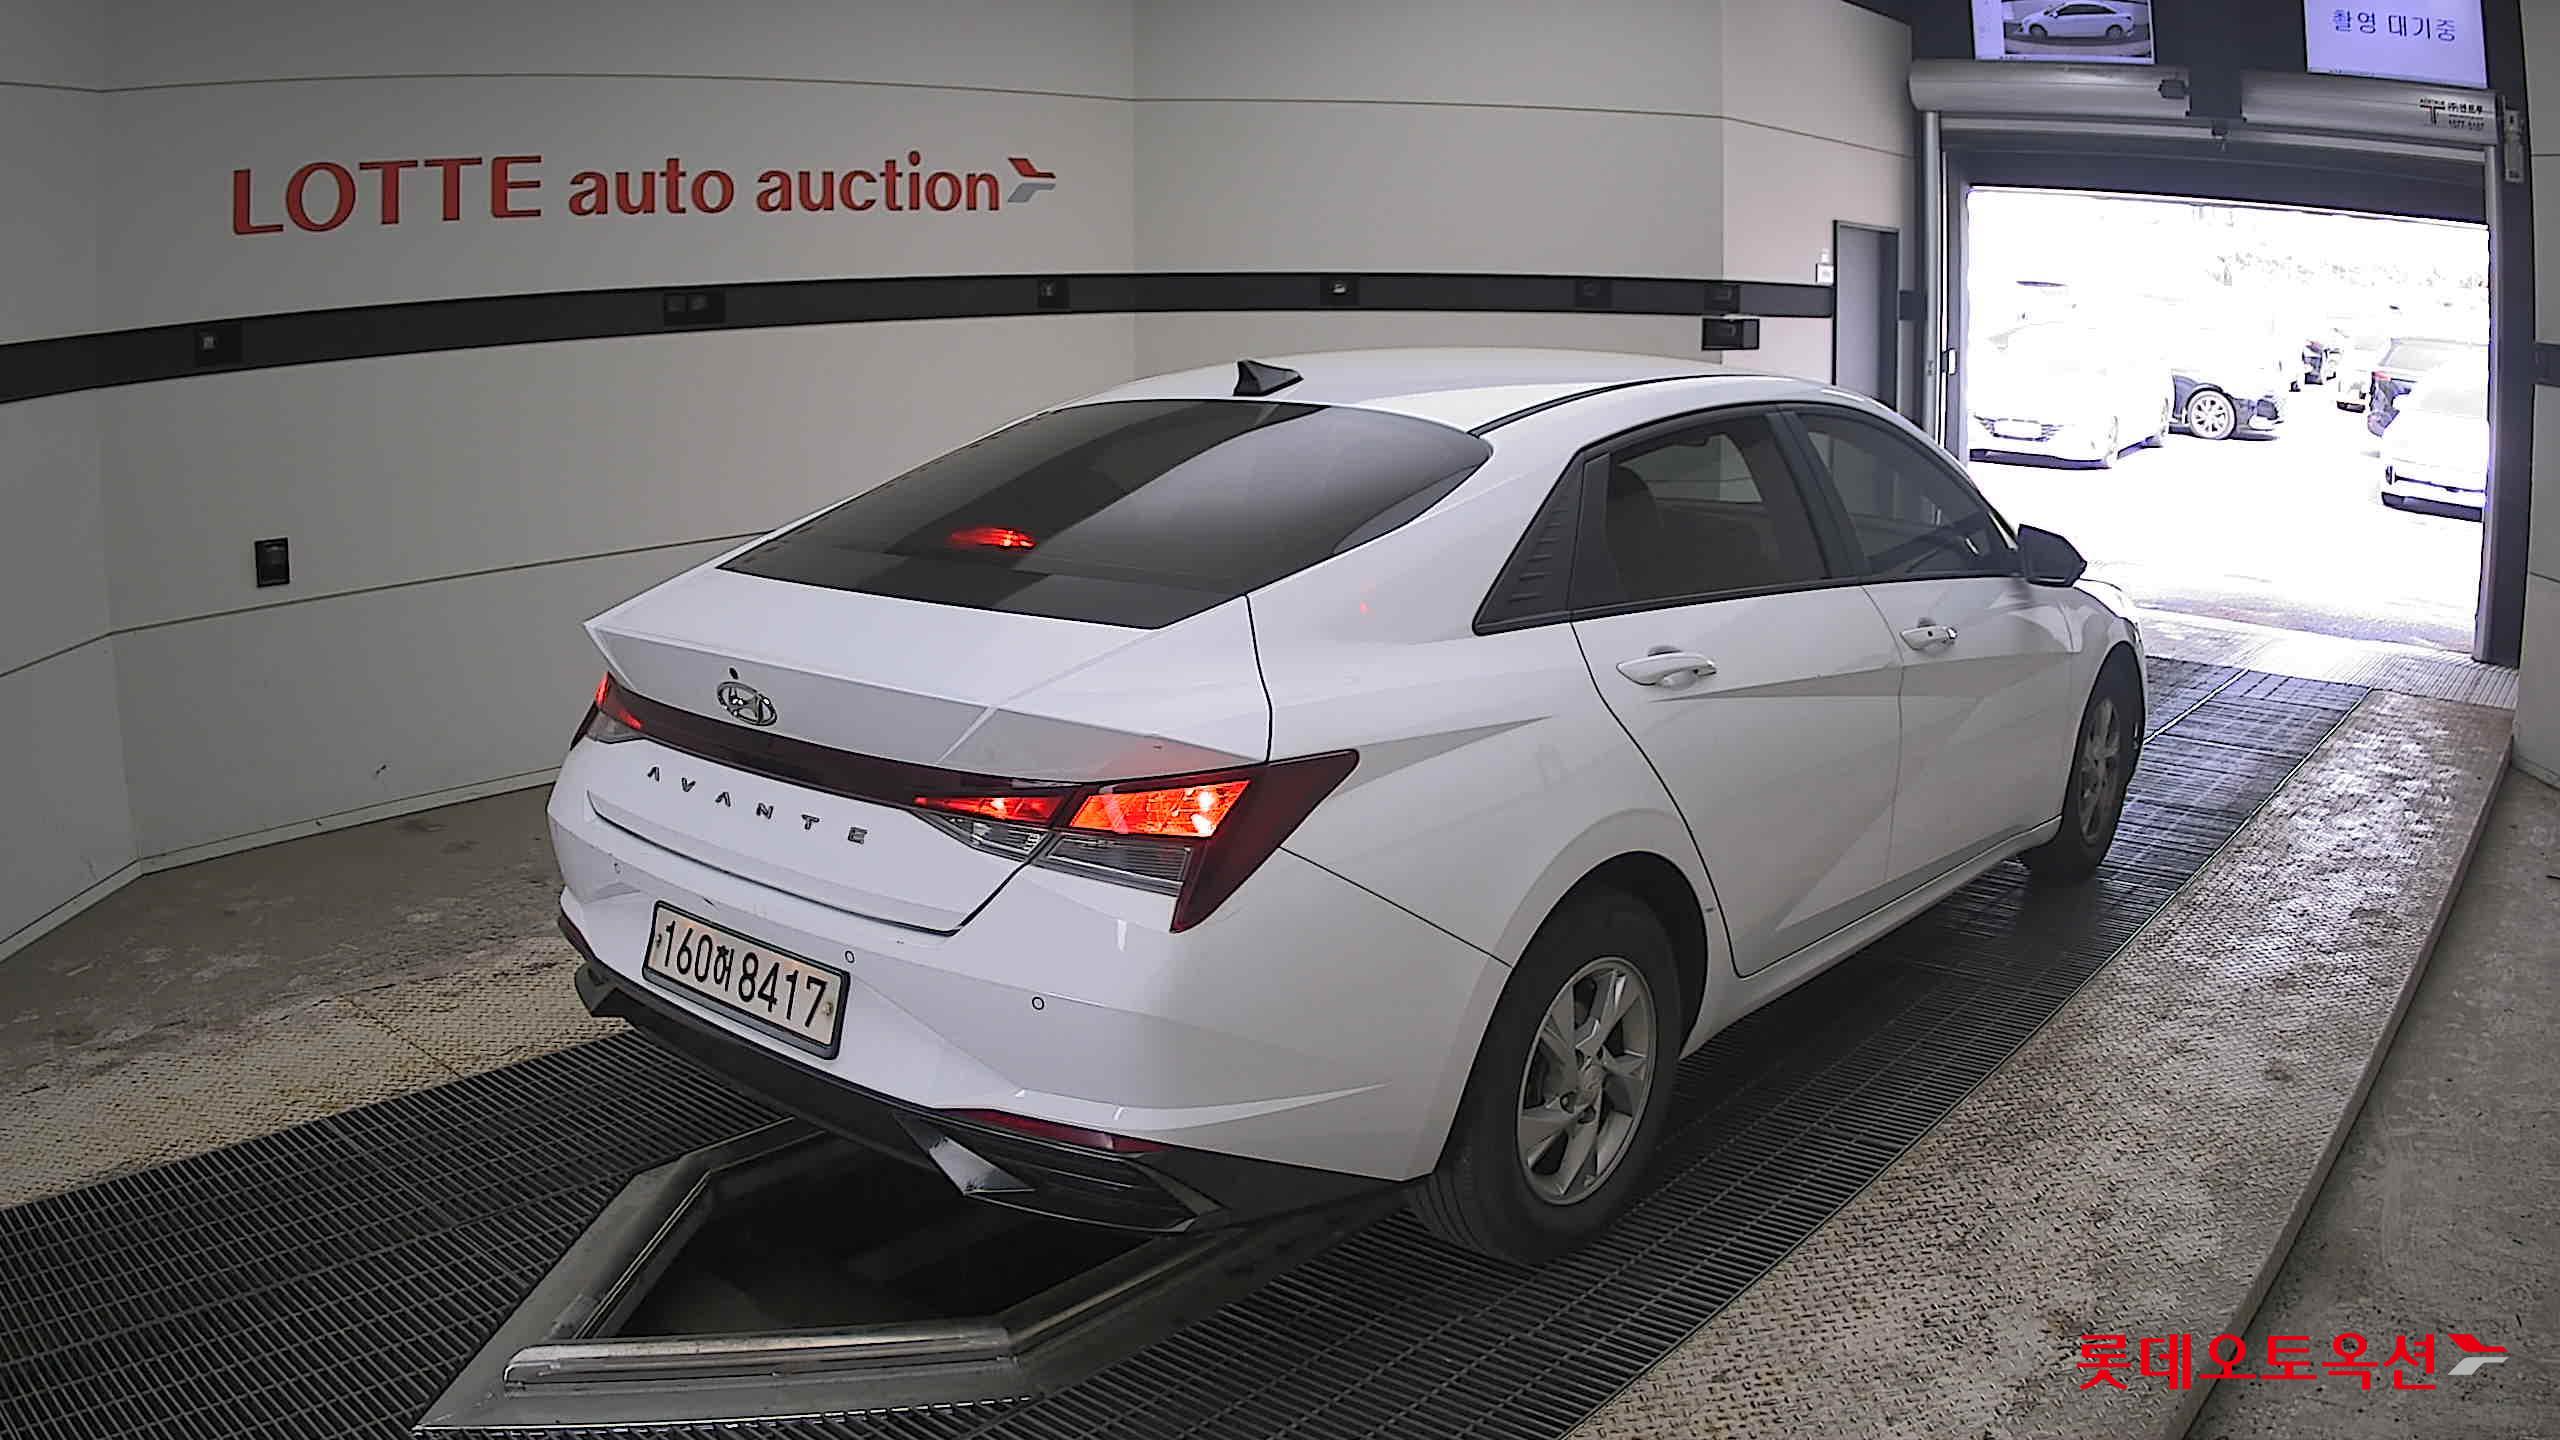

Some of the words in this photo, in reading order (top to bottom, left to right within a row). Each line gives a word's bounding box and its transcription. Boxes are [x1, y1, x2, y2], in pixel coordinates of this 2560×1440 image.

[2333, 10, 2377, 34] 촬영
[2388, 15, 2456, 42] 대기중
[232, 156, 542, 235] LOTTE
[568, 157, 734, 216] auto
[756, 151, 1001, 212] auction
[646, 766, 868, 845] AVANTE
[663, 919, 829, 1028] 160허8417
